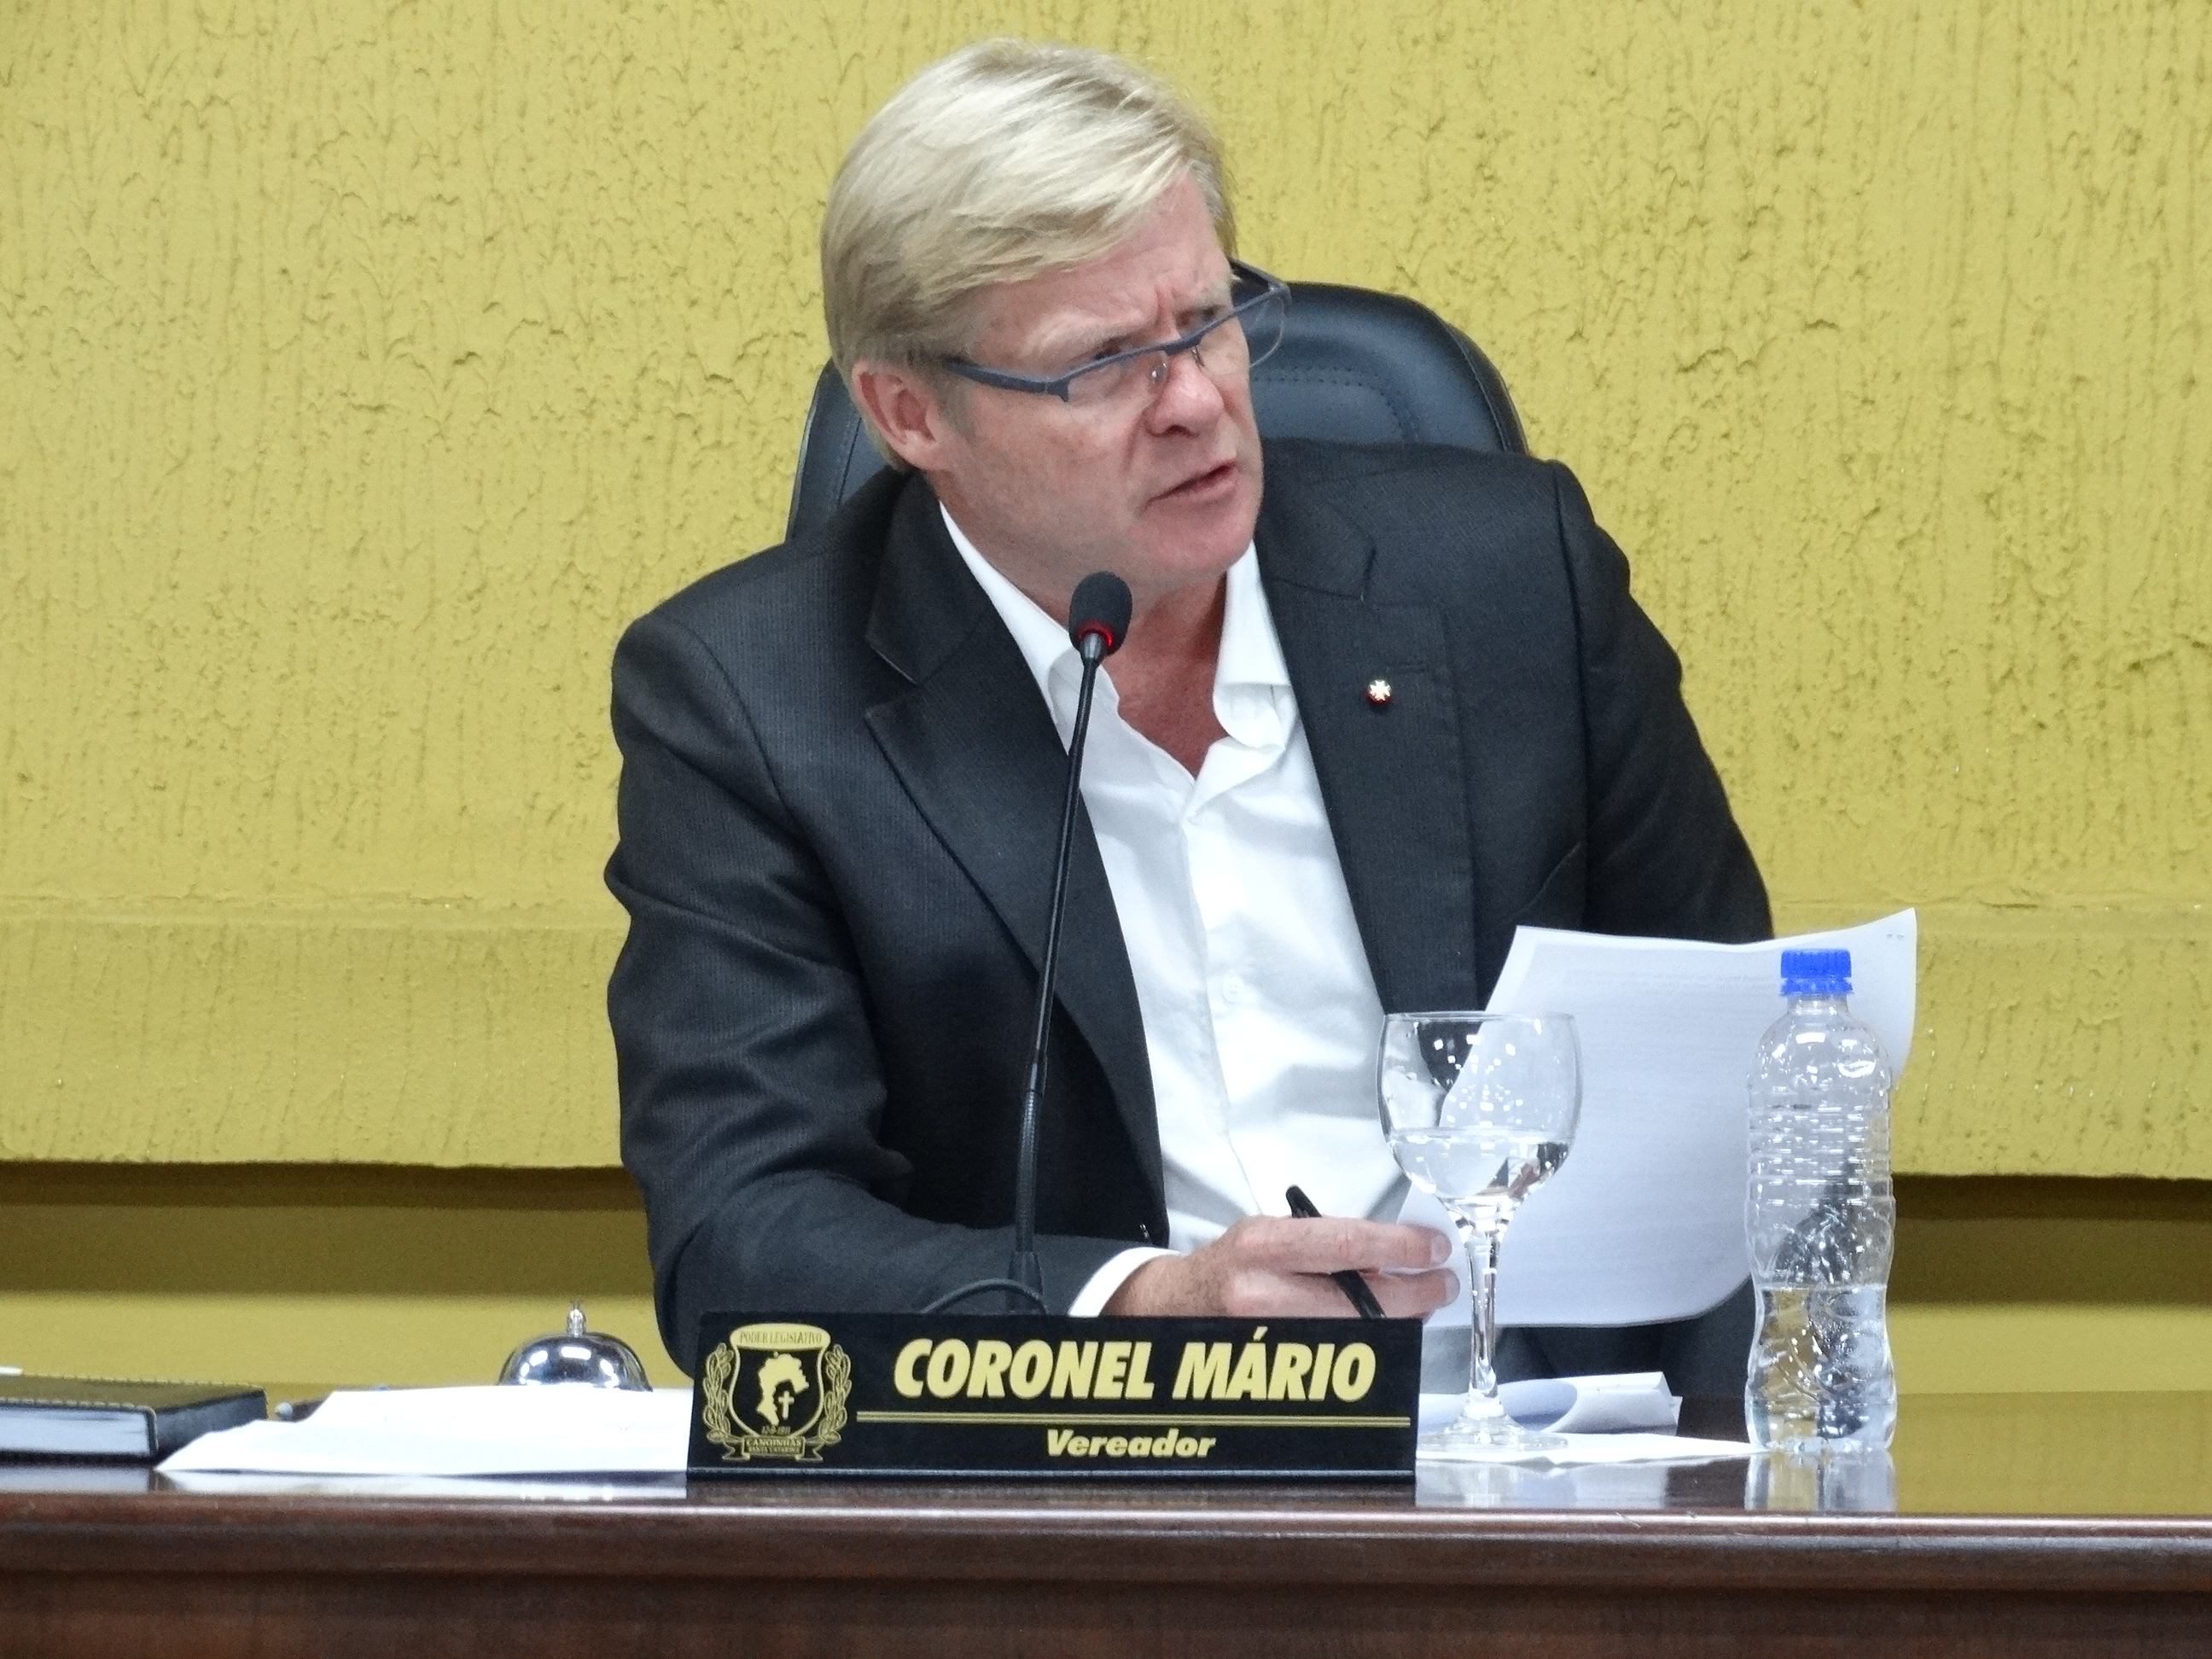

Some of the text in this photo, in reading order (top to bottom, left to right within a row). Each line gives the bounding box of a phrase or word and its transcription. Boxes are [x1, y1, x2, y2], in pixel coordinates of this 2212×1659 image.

[740, 1331, 823, 1345] PODER LEGISLATIVO
[894, 1326, 1377, 1402] CORONEL MÁRIO
[1048, 1429, 1217, 1458] Vereador
